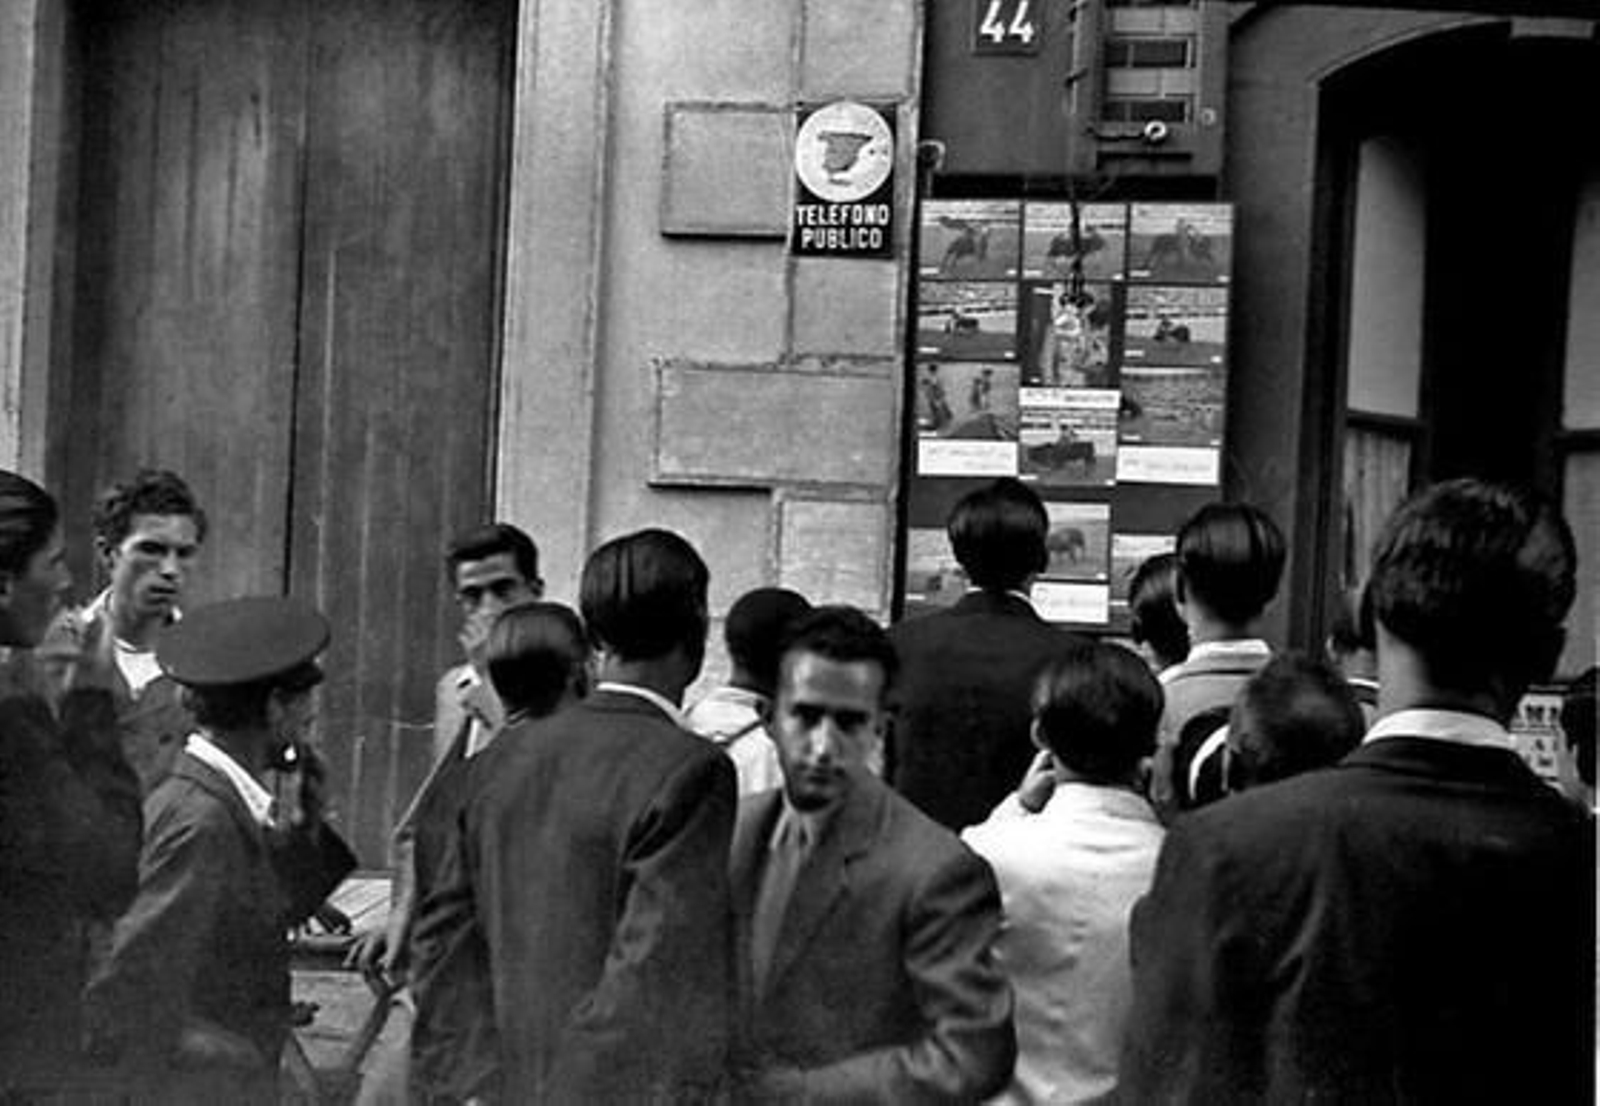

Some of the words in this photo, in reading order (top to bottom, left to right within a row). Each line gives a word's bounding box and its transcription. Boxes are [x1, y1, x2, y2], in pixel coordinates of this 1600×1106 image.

[980, 0, 1034, 43] 44
[796, 204, 889, 226] TELEFONO
[801, 227, 883, 249] PUBLICO
